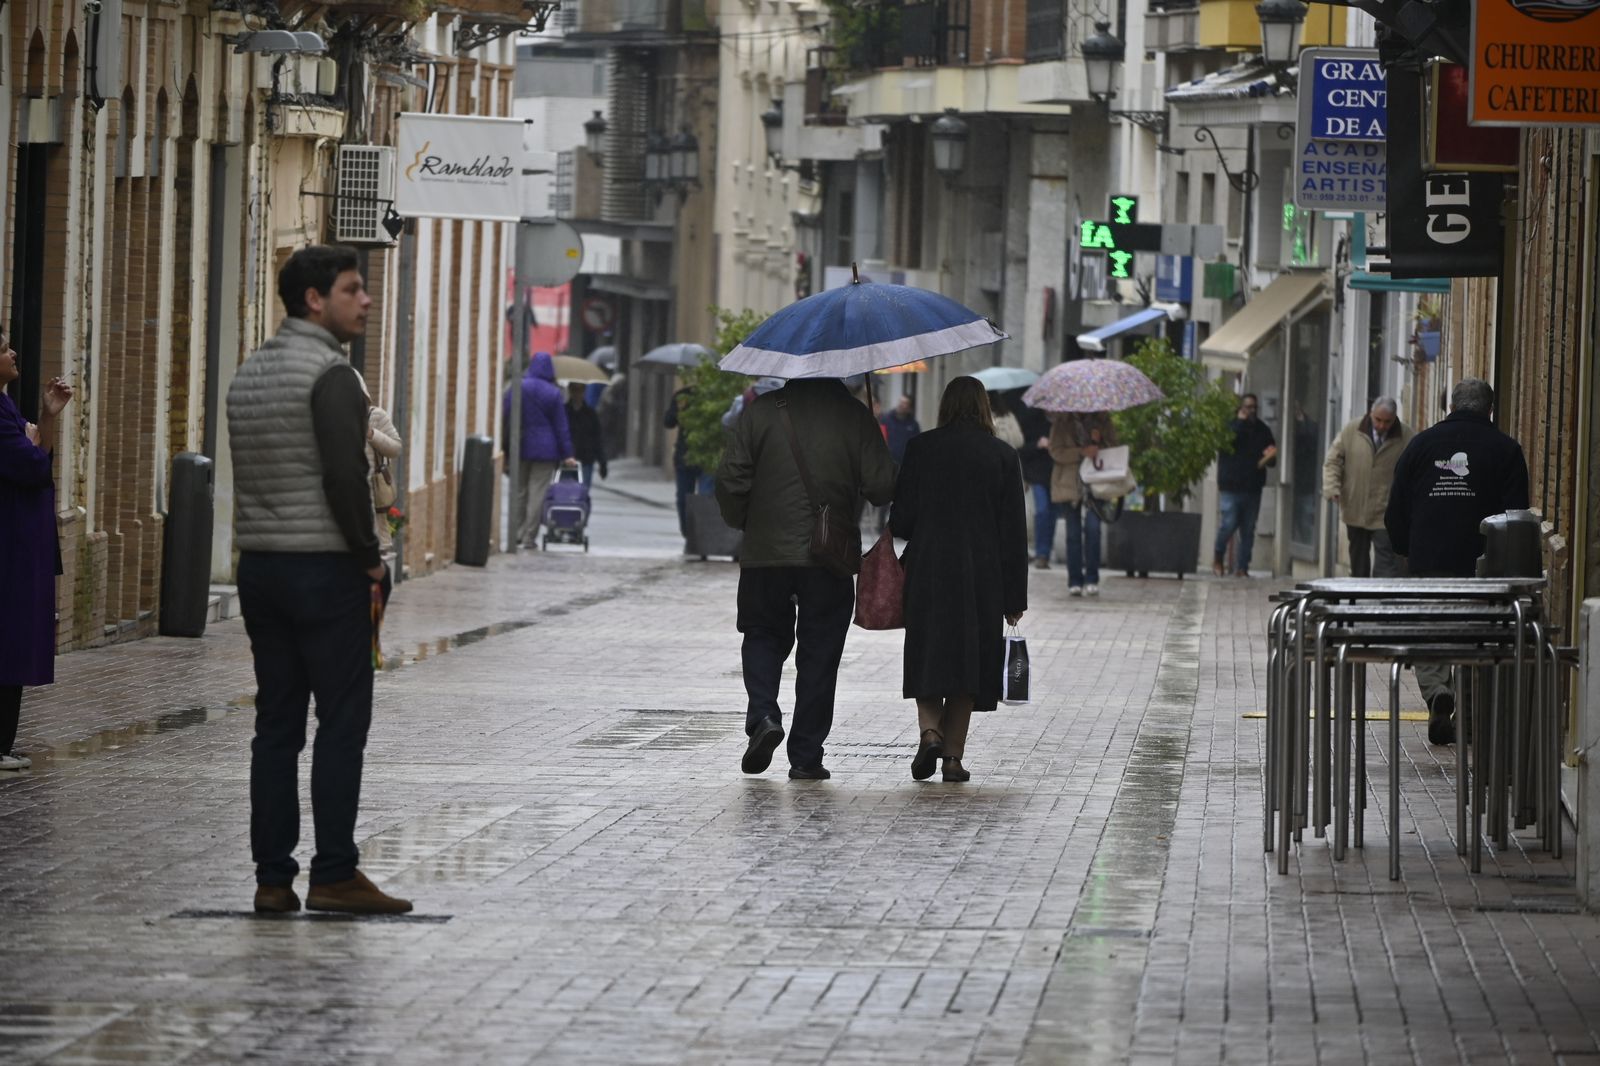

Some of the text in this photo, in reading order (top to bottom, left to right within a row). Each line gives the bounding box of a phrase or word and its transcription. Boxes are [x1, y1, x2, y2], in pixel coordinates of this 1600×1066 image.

[1488, 84, 1600, 114] CAFETERI
[1325, 117, 1360, 135] DE
[1303, 143, 1378, 156] ACAD
[419, 155, 514, 178] Ramblado
[1425, 172, 1471, 244] GE
